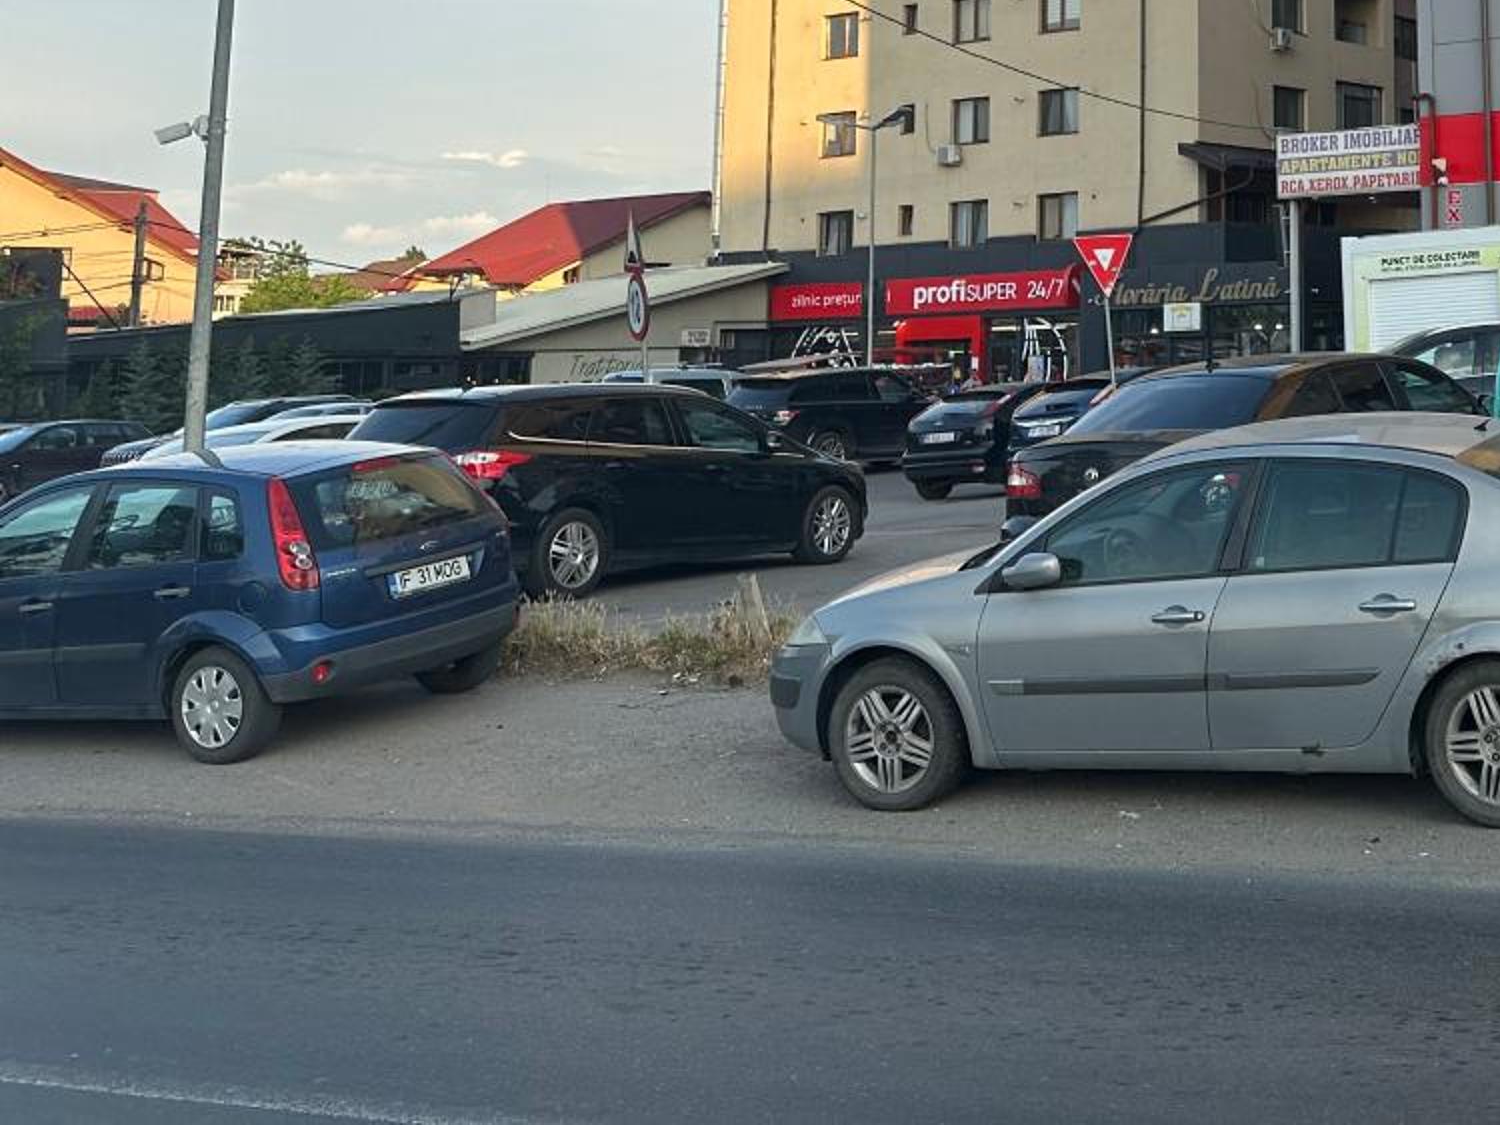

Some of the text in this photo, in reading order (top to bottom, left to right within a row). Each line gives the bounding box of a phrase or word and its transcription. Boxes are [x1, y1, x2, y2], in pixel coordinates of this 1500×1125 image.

[1280, 135, 1339, 154] BROKER
[1280, 153, 1393, 174] APARTAMENTE
[1381, 256, 1411, 266] PUNCT
[1413, 254, 1425, 264] DE
[1027, 279, 1064, 301] 24/7
[791, 294, 821, 308] zilnic
[417, 568, 433, 585] 31
[433, 560, 463, 582] MOG
